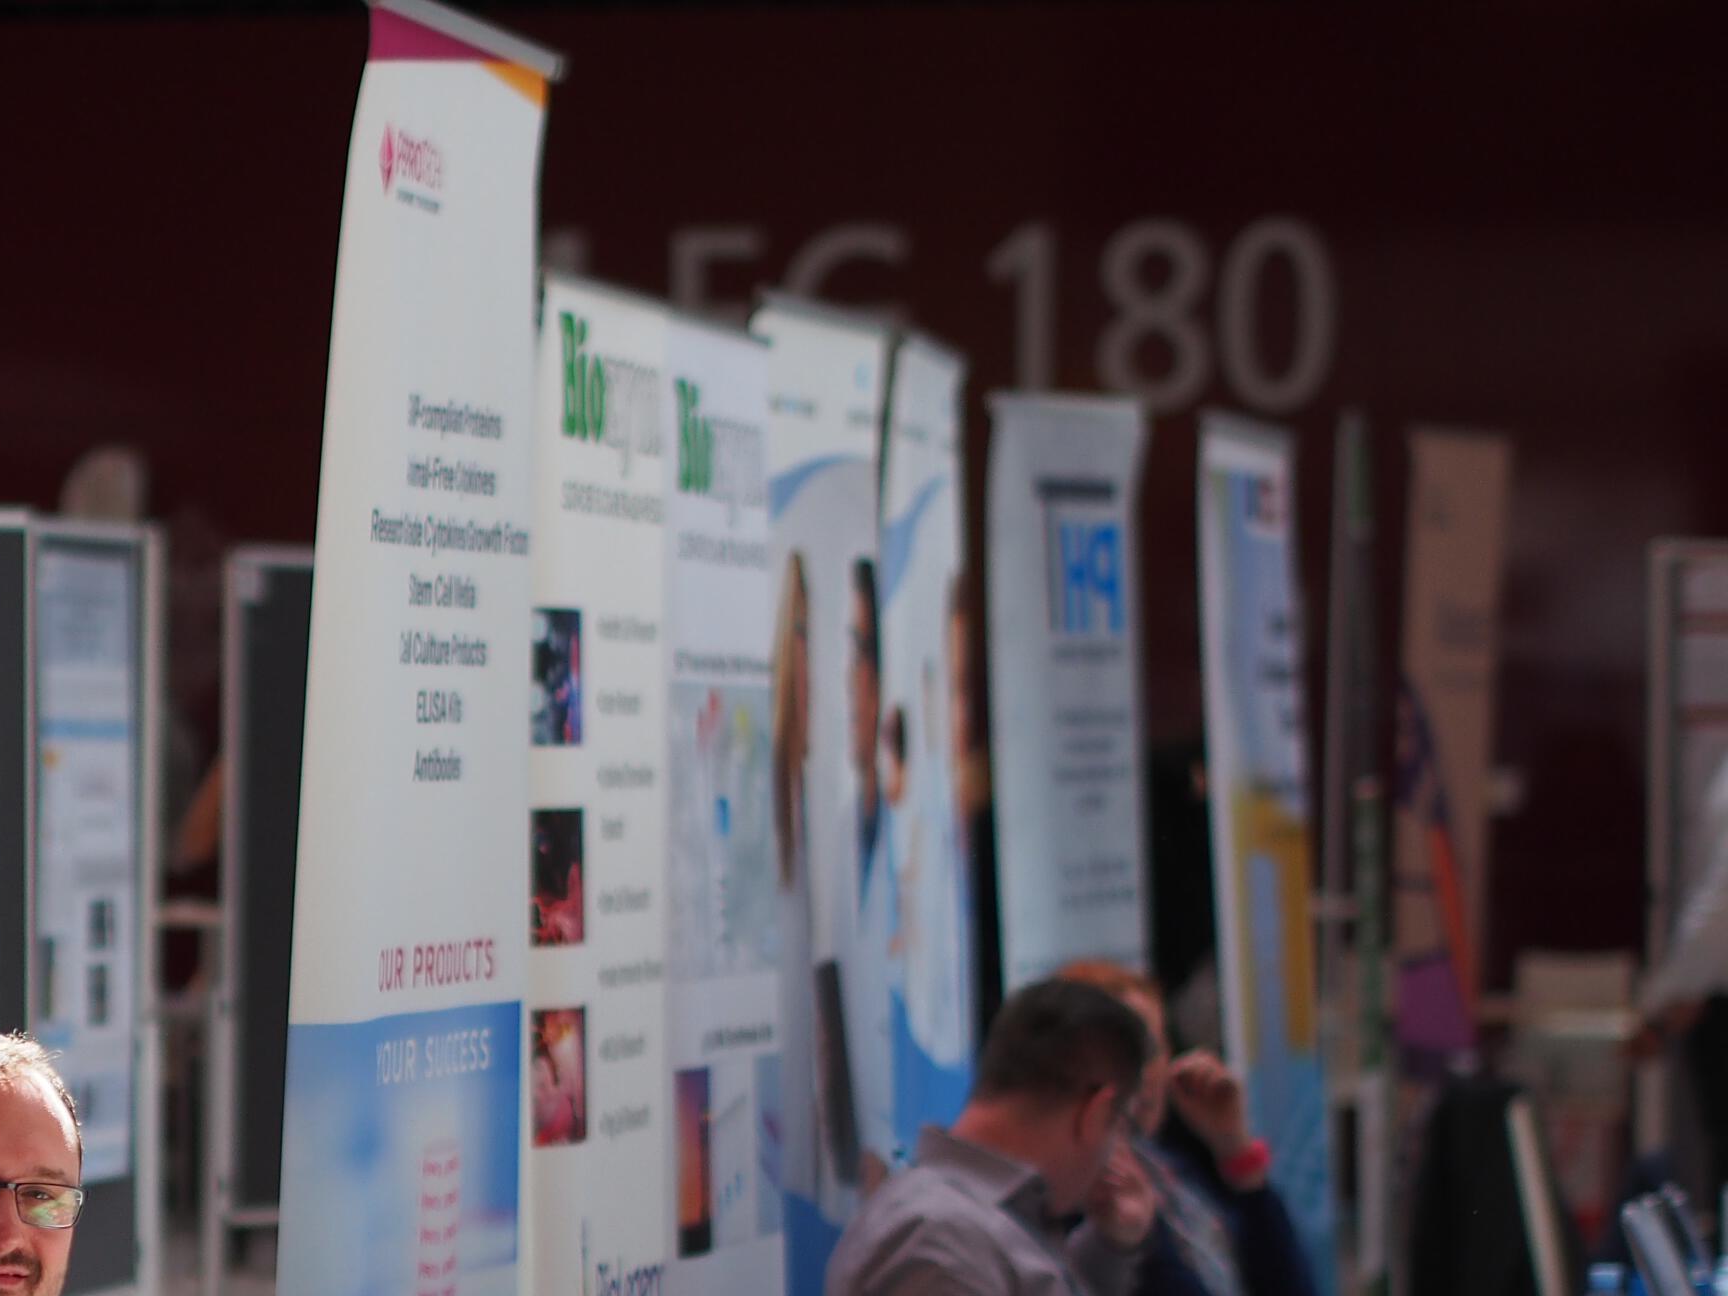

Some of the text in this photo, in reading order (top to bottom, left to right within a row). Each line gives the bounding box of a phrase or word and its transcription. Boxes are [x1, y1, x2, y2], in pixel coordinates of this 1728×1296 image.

[377, 938, 495, 993] OUR PRODUCTS
[375, 1028, 492, 1087] YOUR SUCCESS
